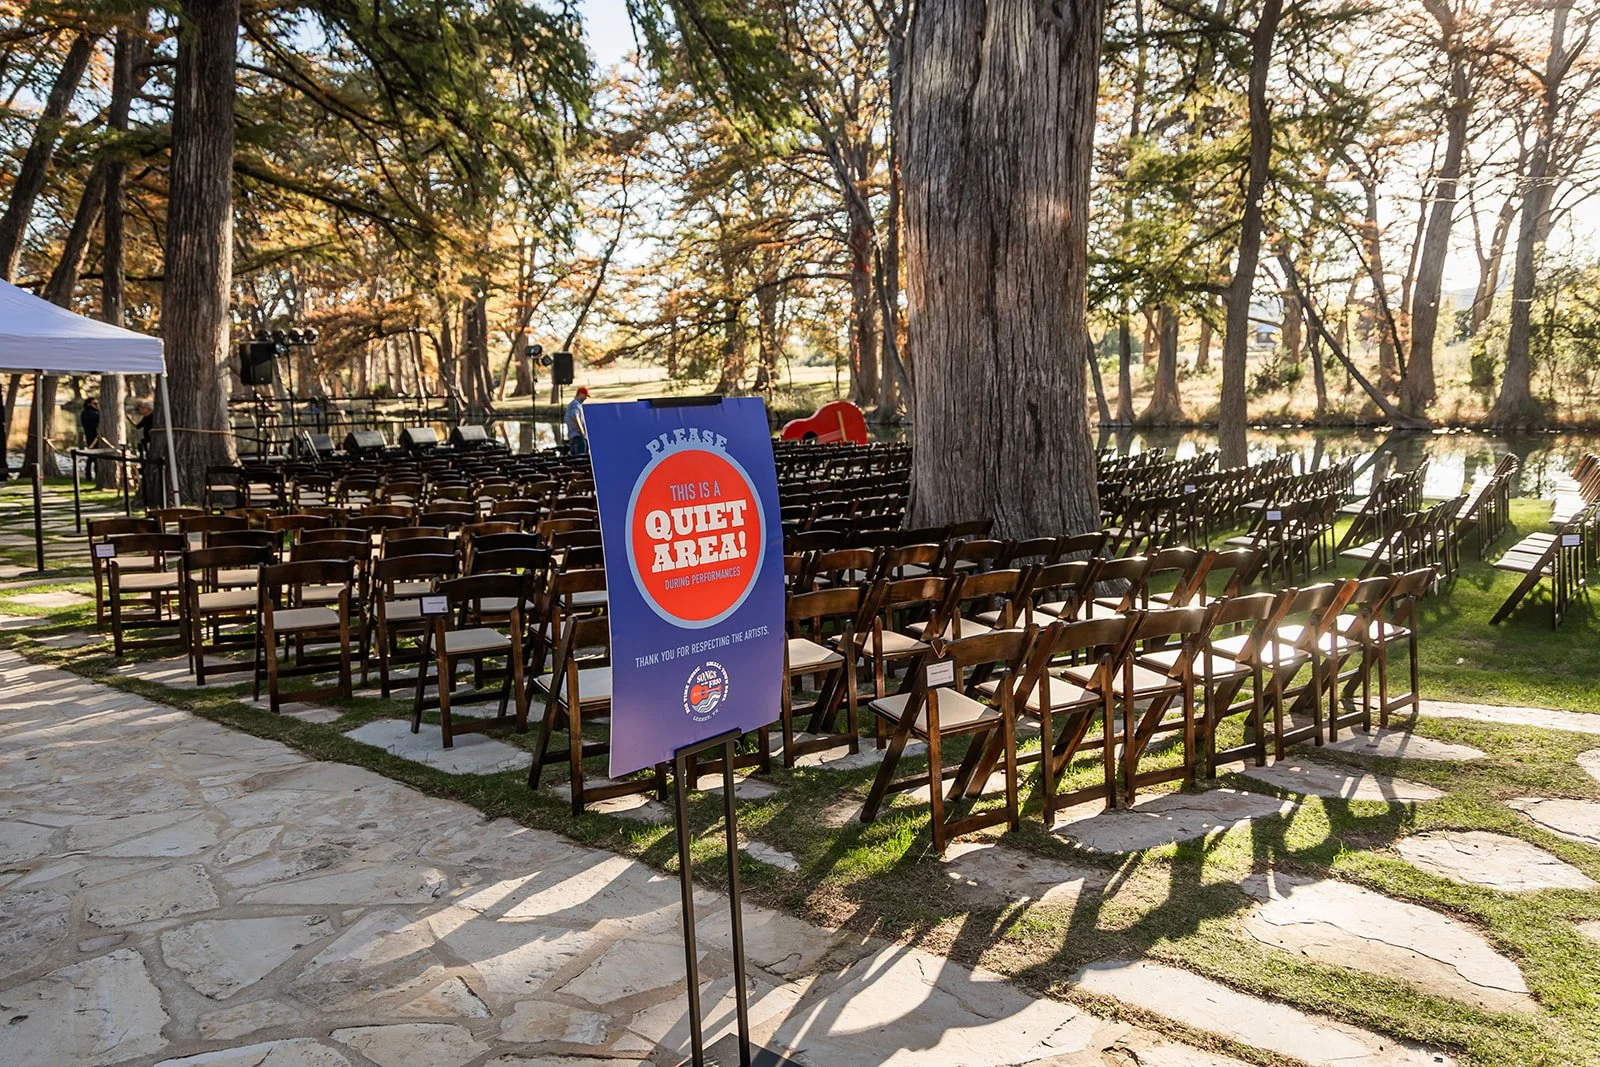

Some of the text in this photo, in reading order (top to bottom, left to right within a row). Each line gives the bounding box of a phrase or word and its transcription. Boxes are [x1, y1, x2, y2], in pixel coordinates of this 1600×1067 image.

[645, 428, 728, 457] PLEASE
[669, 480, 721, 501] THIS IS A
[645, 499, 748, 541] QUIET
[651, 530, 748, 574] AREA!
[665, 566, 741, 590] DURING PERFORMANCES
[635, 625, 769, 668] THANK YOU FOR RESPECTING THE ARTISTS.
[687, 666, 701, 684] MUSIC
[696, 670, 717, 684] SONGS
[706, 661, 722, 670] SMALL
[721, 667, 729, 685] TOWN
